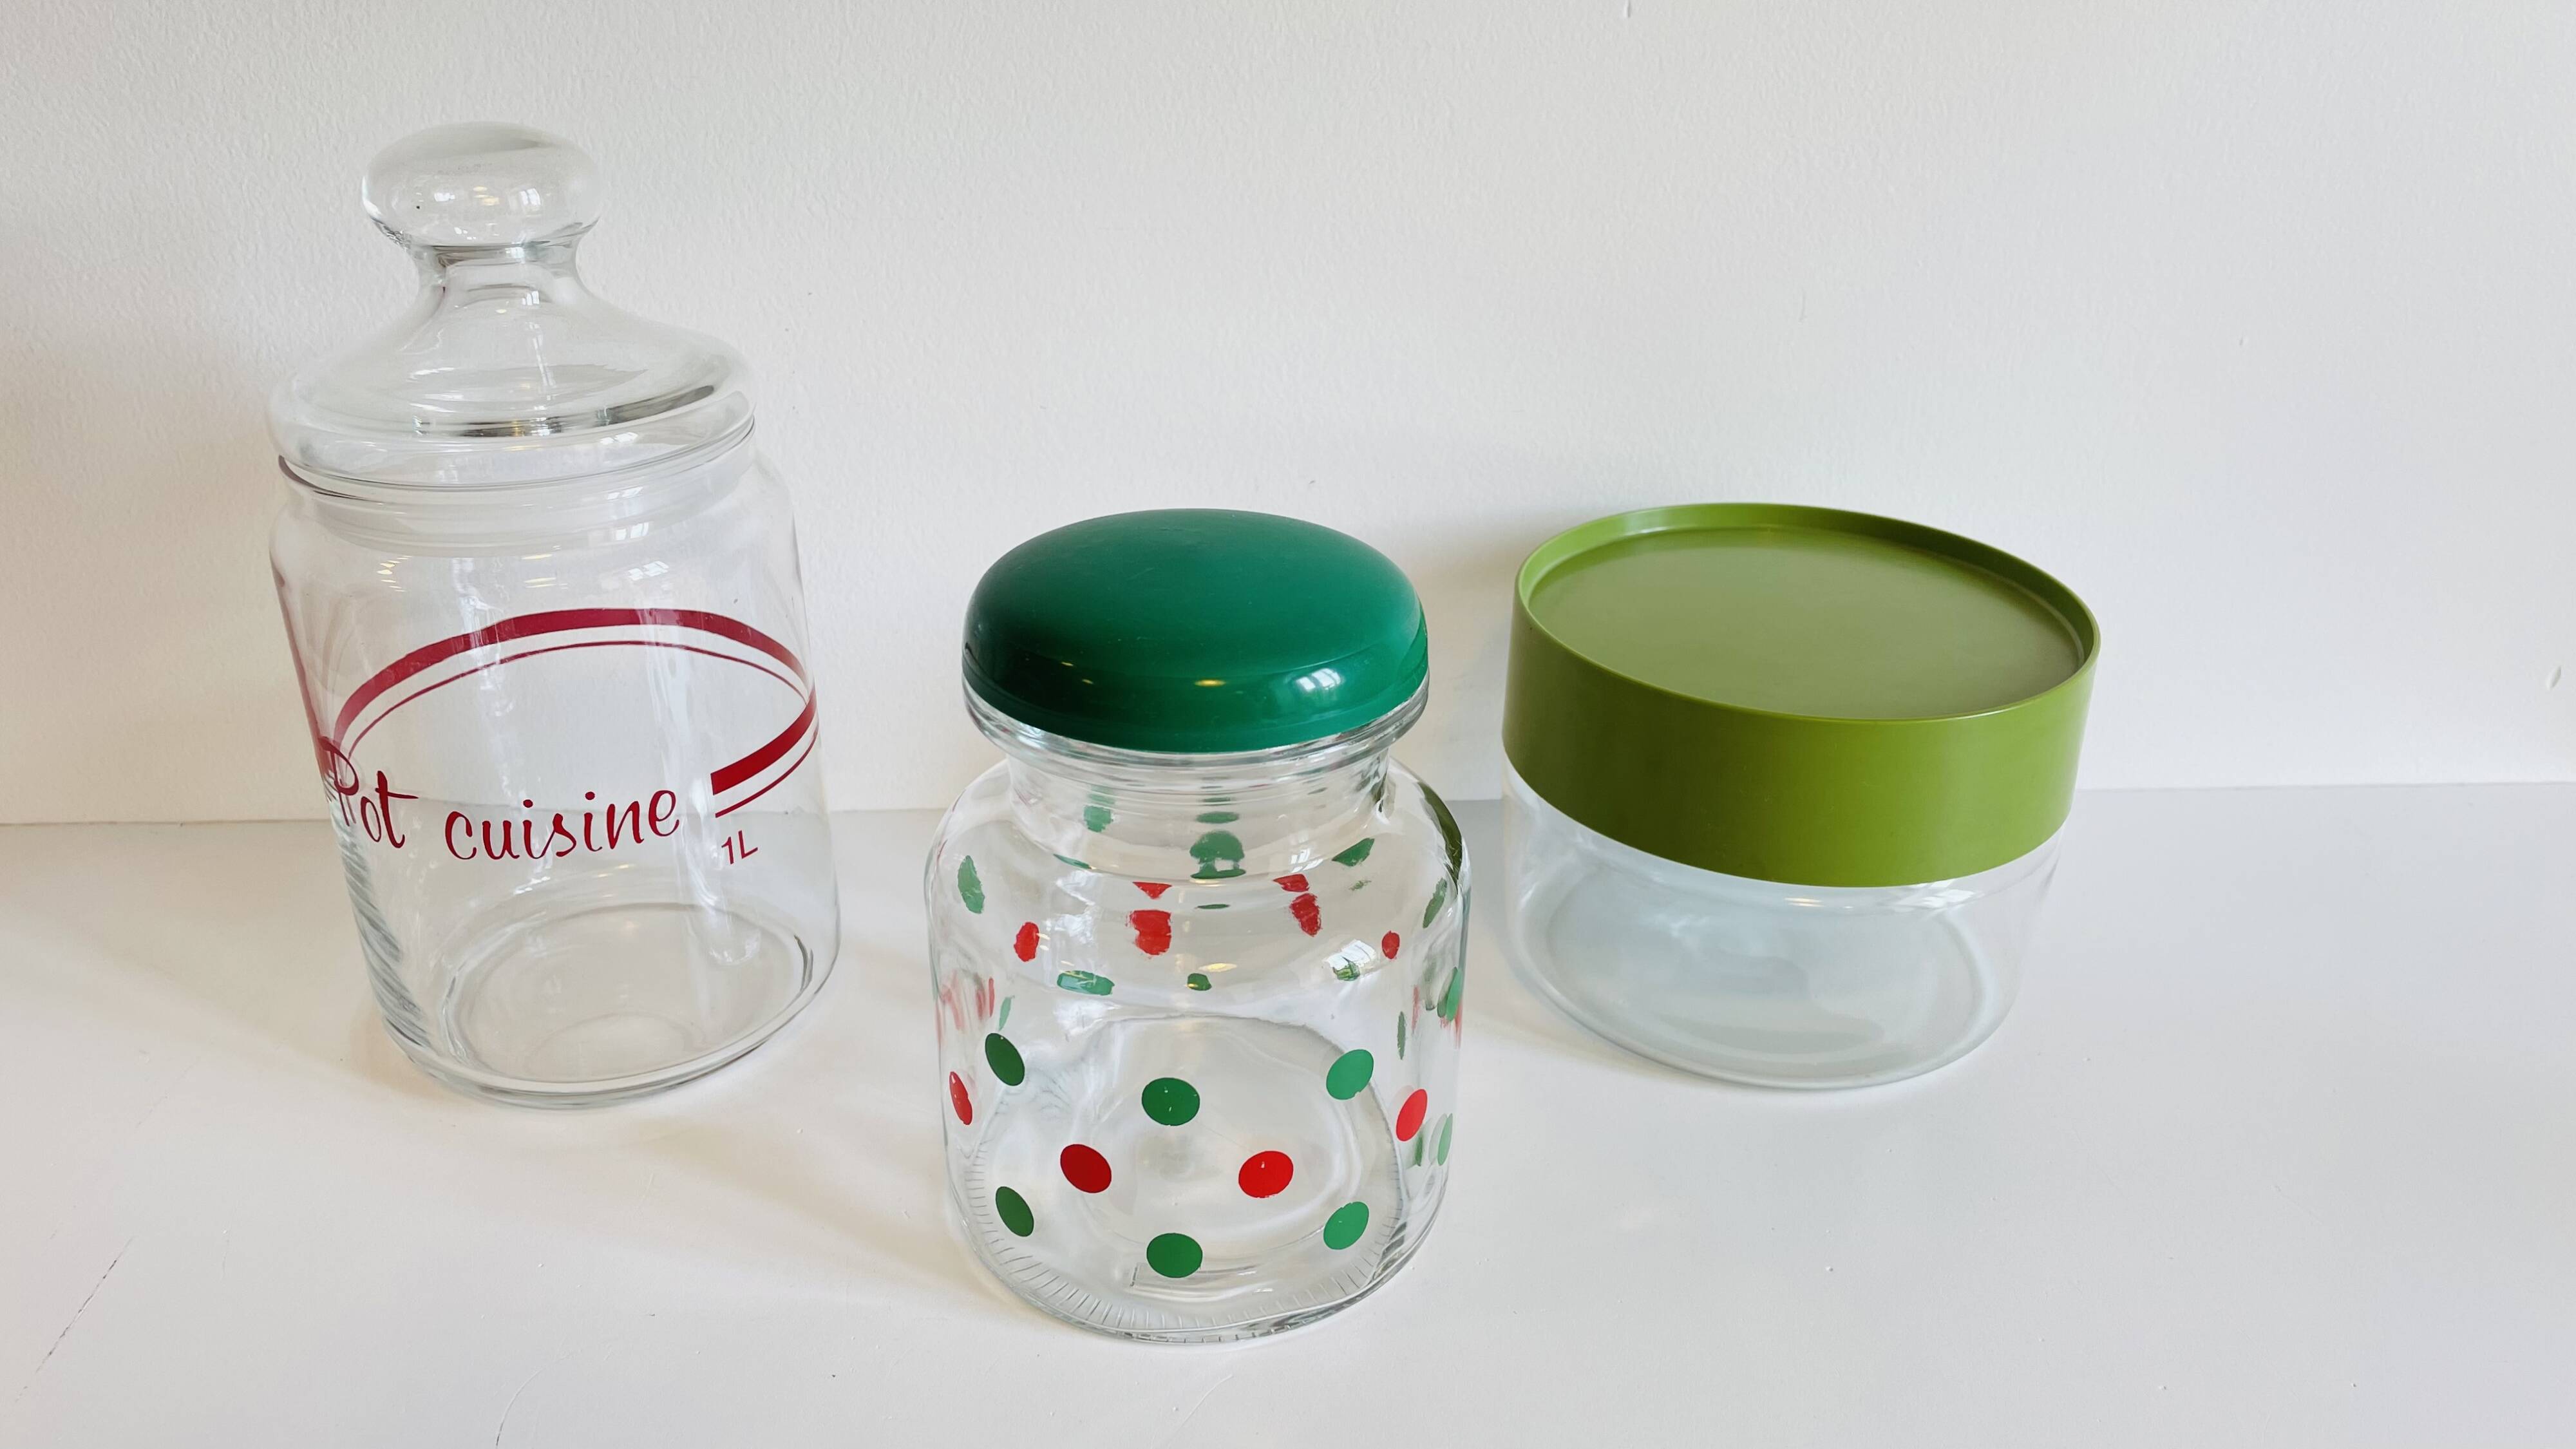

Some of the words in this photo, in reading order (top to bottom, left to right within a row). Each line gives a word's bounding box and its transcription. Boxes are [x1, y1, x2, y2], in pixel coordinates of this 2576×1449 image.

[319, 736, 419, 849] Pot
[444, 790, 680, 860] cuisine
[721, 829, 758, 864] 1L
